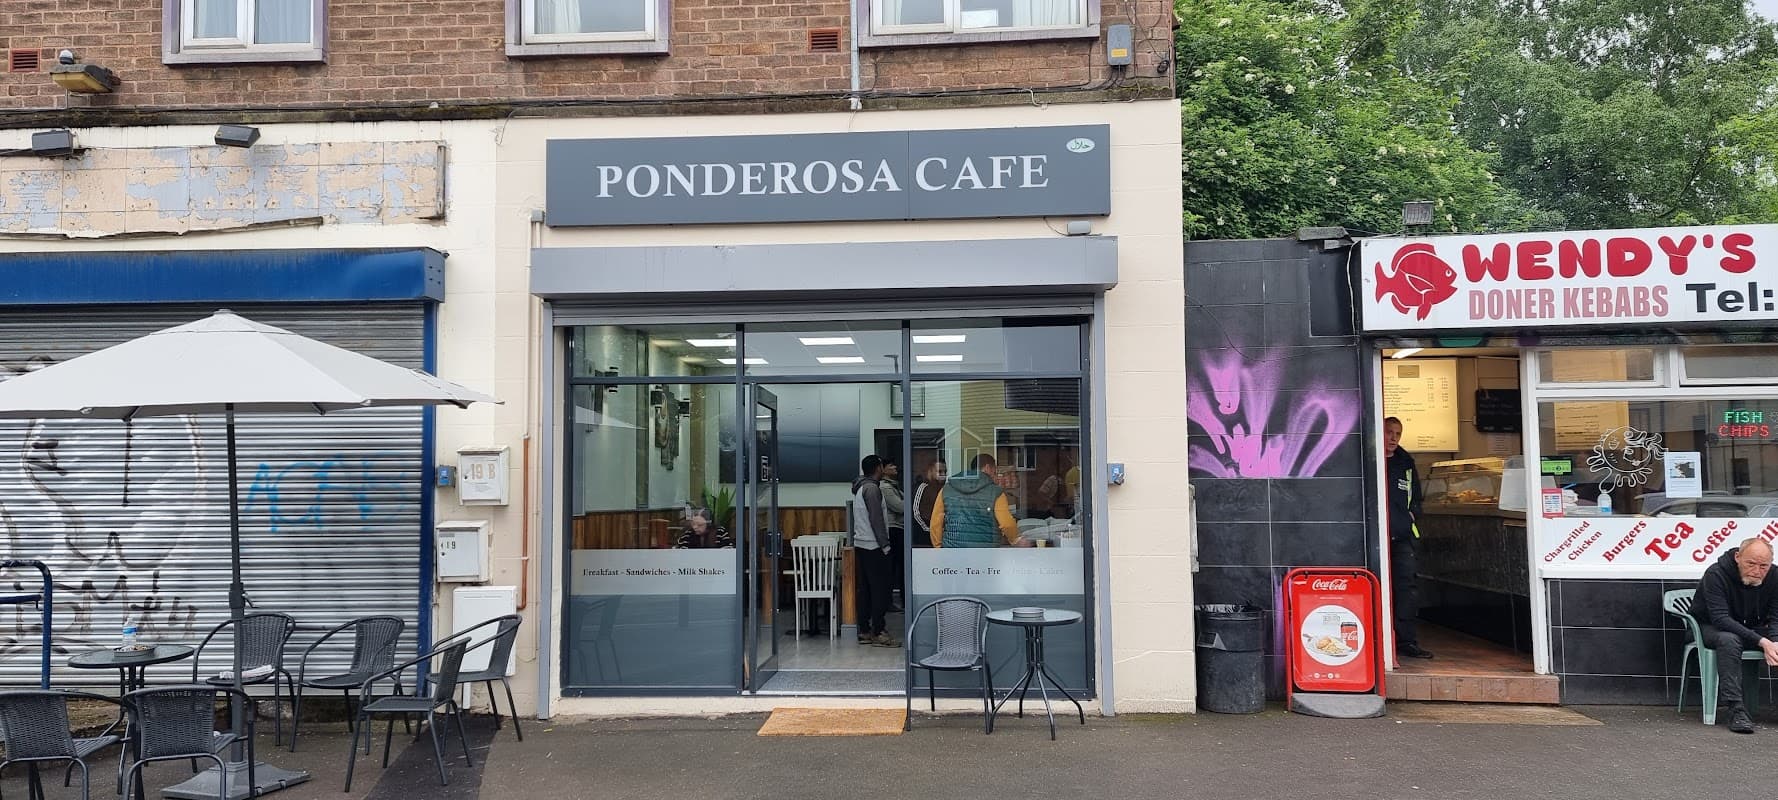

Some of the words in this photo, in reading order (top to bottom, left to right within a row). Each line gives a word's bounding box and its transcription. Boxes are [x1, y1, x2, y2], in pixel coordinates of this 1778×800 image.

[596, 159, 902, 199] PONDEROSA
[915, 154, 1049, 193] CAFE
[1461, 232, 1757, 284] WENDY'S
[1468, 288, 1556, 320] DONER
[1562, 285, 1669, 318] KEBABS
[1685, 281, 1775, 313] Tel:
[1718, 424, 1770, 437] CHIPS
[1724, 411, 1764, 424] FISH
[470, 463, 484, 480] 19
[1543, 520, 1591, 563] Chargrilled
[1568, 529, 1603, 561] Chicken
[1601, 520, 1647, 563] Burgers
[1644, 520, 1695, 562] Tea
[1691, 518, 1739, 563] Coffee
[626, 568, 670, 576] Sandwiches
[678, 567, 696, 576] Milk
[698, 567, 725, 576] Shakes
[931, 567, 958, 576] Coffee
[966, 567, 980, 575] Tea
